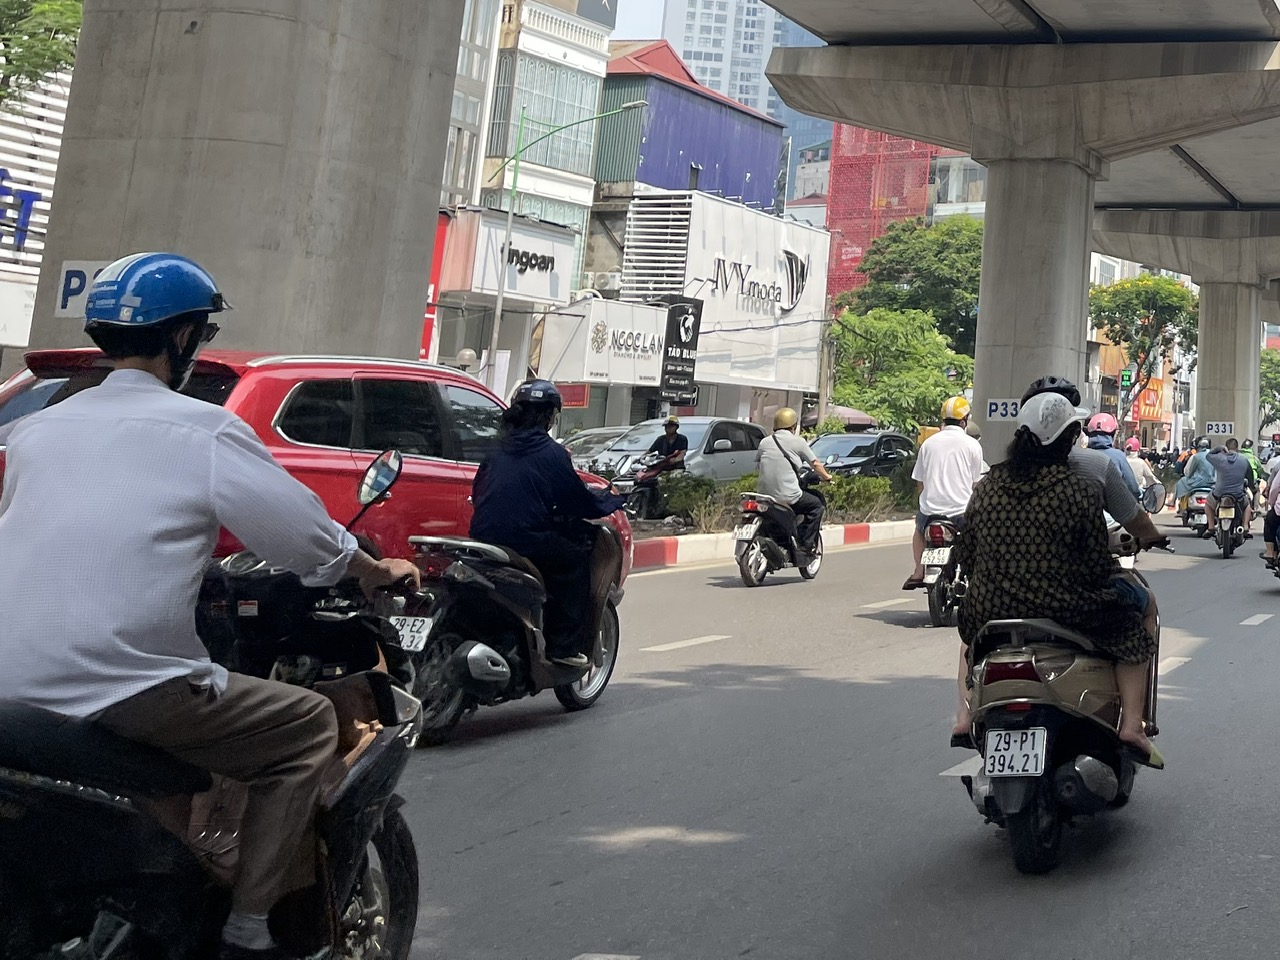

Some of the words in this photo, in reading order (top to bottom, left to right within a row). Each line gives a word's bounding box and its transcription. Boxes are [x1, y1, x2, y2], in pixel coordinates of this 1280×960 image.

[714, 257, 752, 295] IVY
[748, 281, 782, 303] moda
[988, 401, 1019, 418] P33
[1207, 423, 1233, 435] P331
[394, 617, 425, 634] 29-E2
[993, 731, 1037, 752] 29-P1
[987, 752, 1040, 774] 394.21
